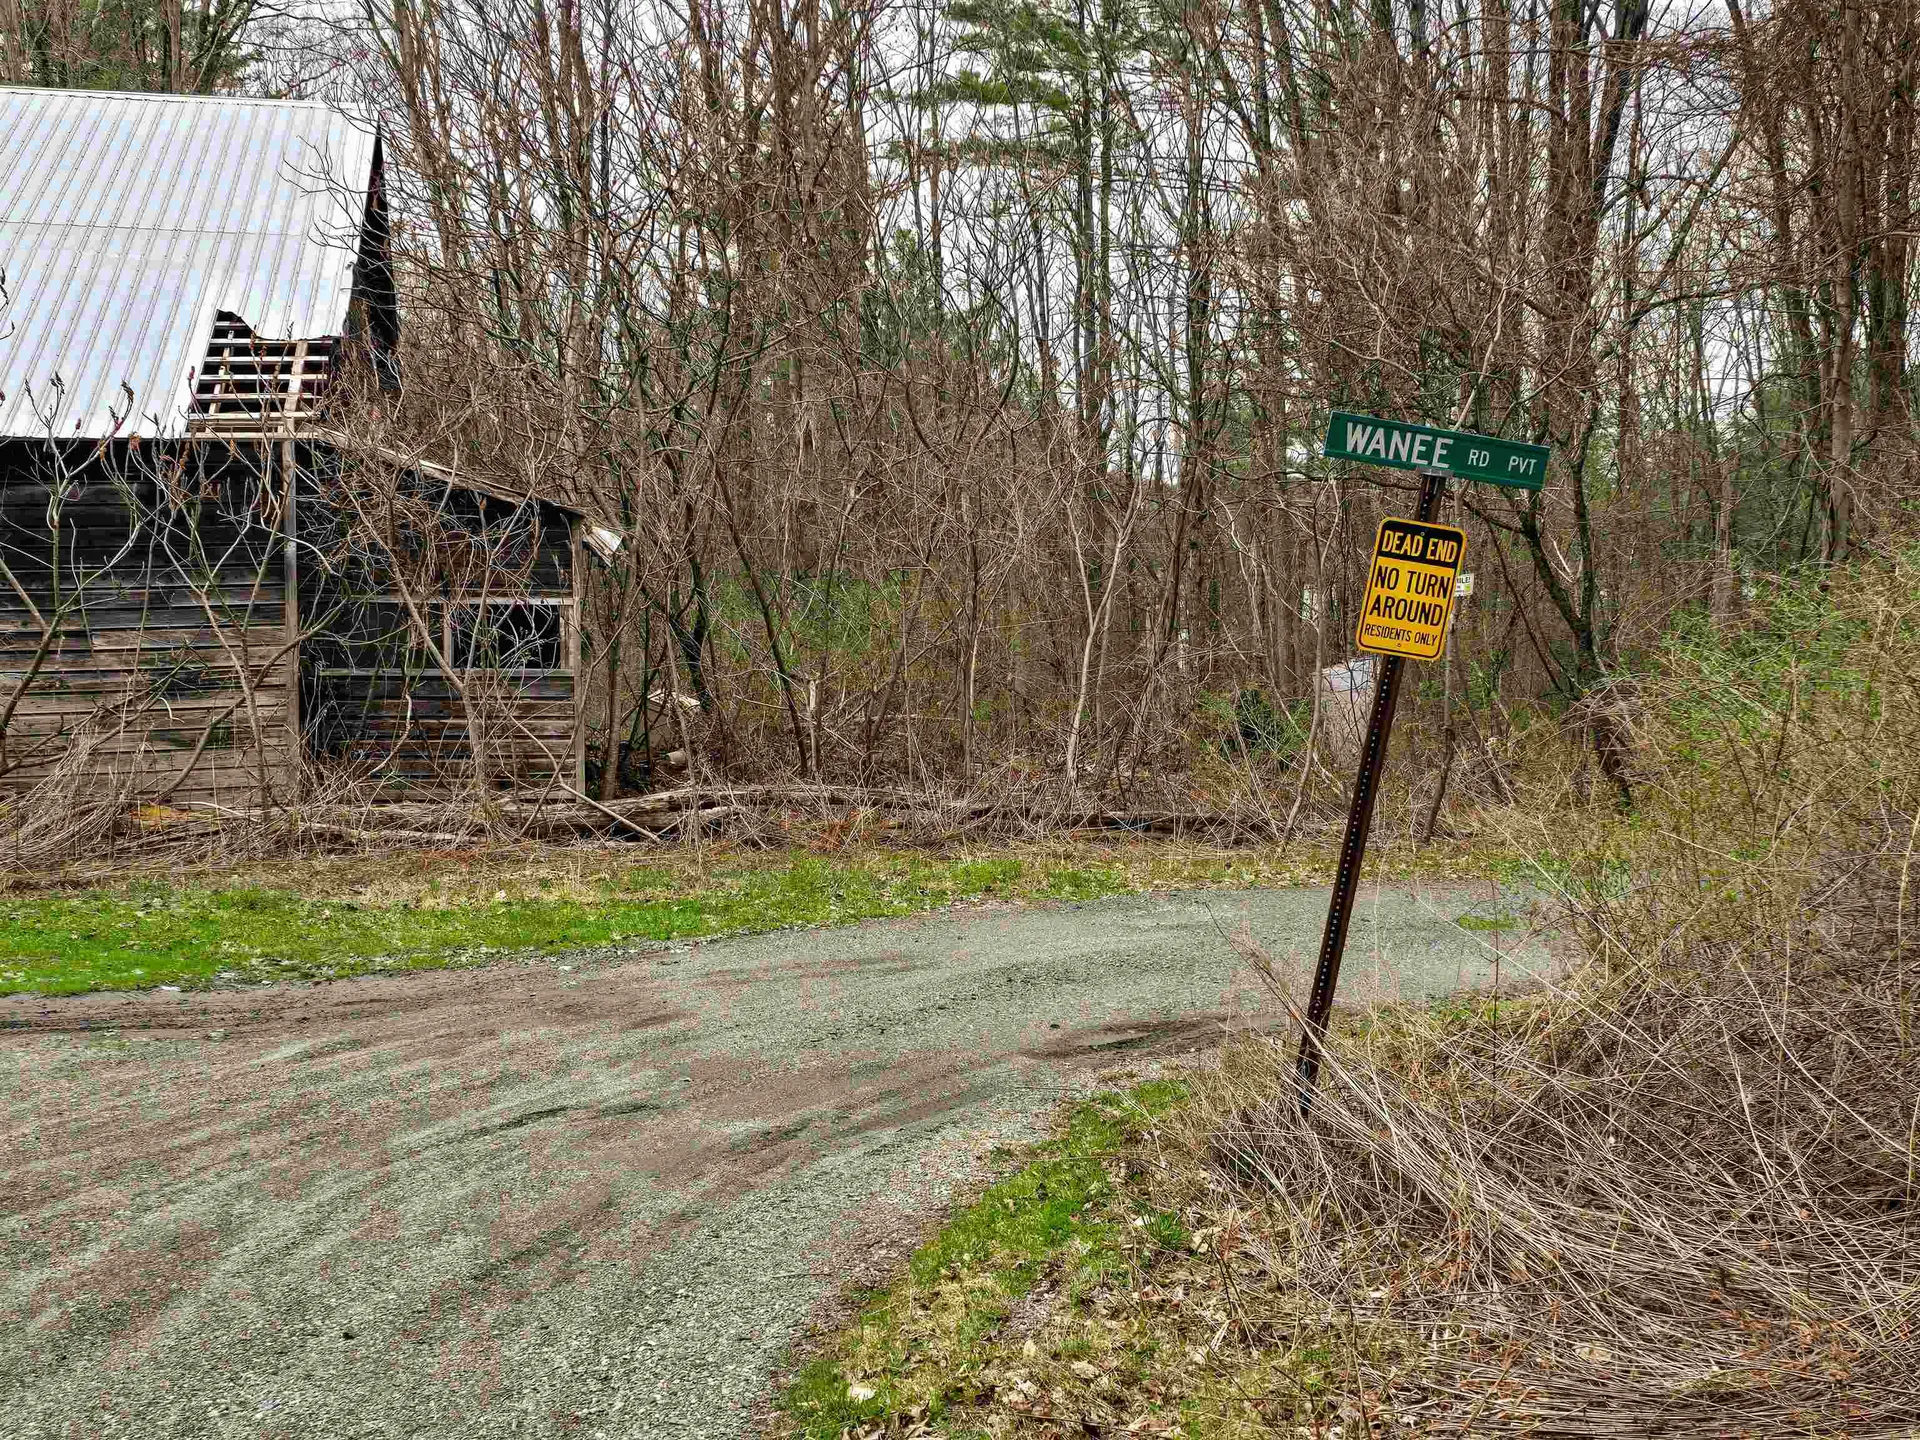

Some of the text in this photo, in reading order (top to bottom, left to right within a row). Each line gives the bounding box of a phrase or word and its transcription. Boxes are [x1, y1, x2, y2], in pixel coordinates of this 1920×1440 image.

[1346, 422, 1537, 476] WANEE RD PVT
[1381, 530, 1458, 563] DEAD END
[1374, 565, 1451, 599] NO TURN
[1369, 594, 1443, 627] AROUND
[1364, 623, 1438, 646] RESIDENTS ONLY
